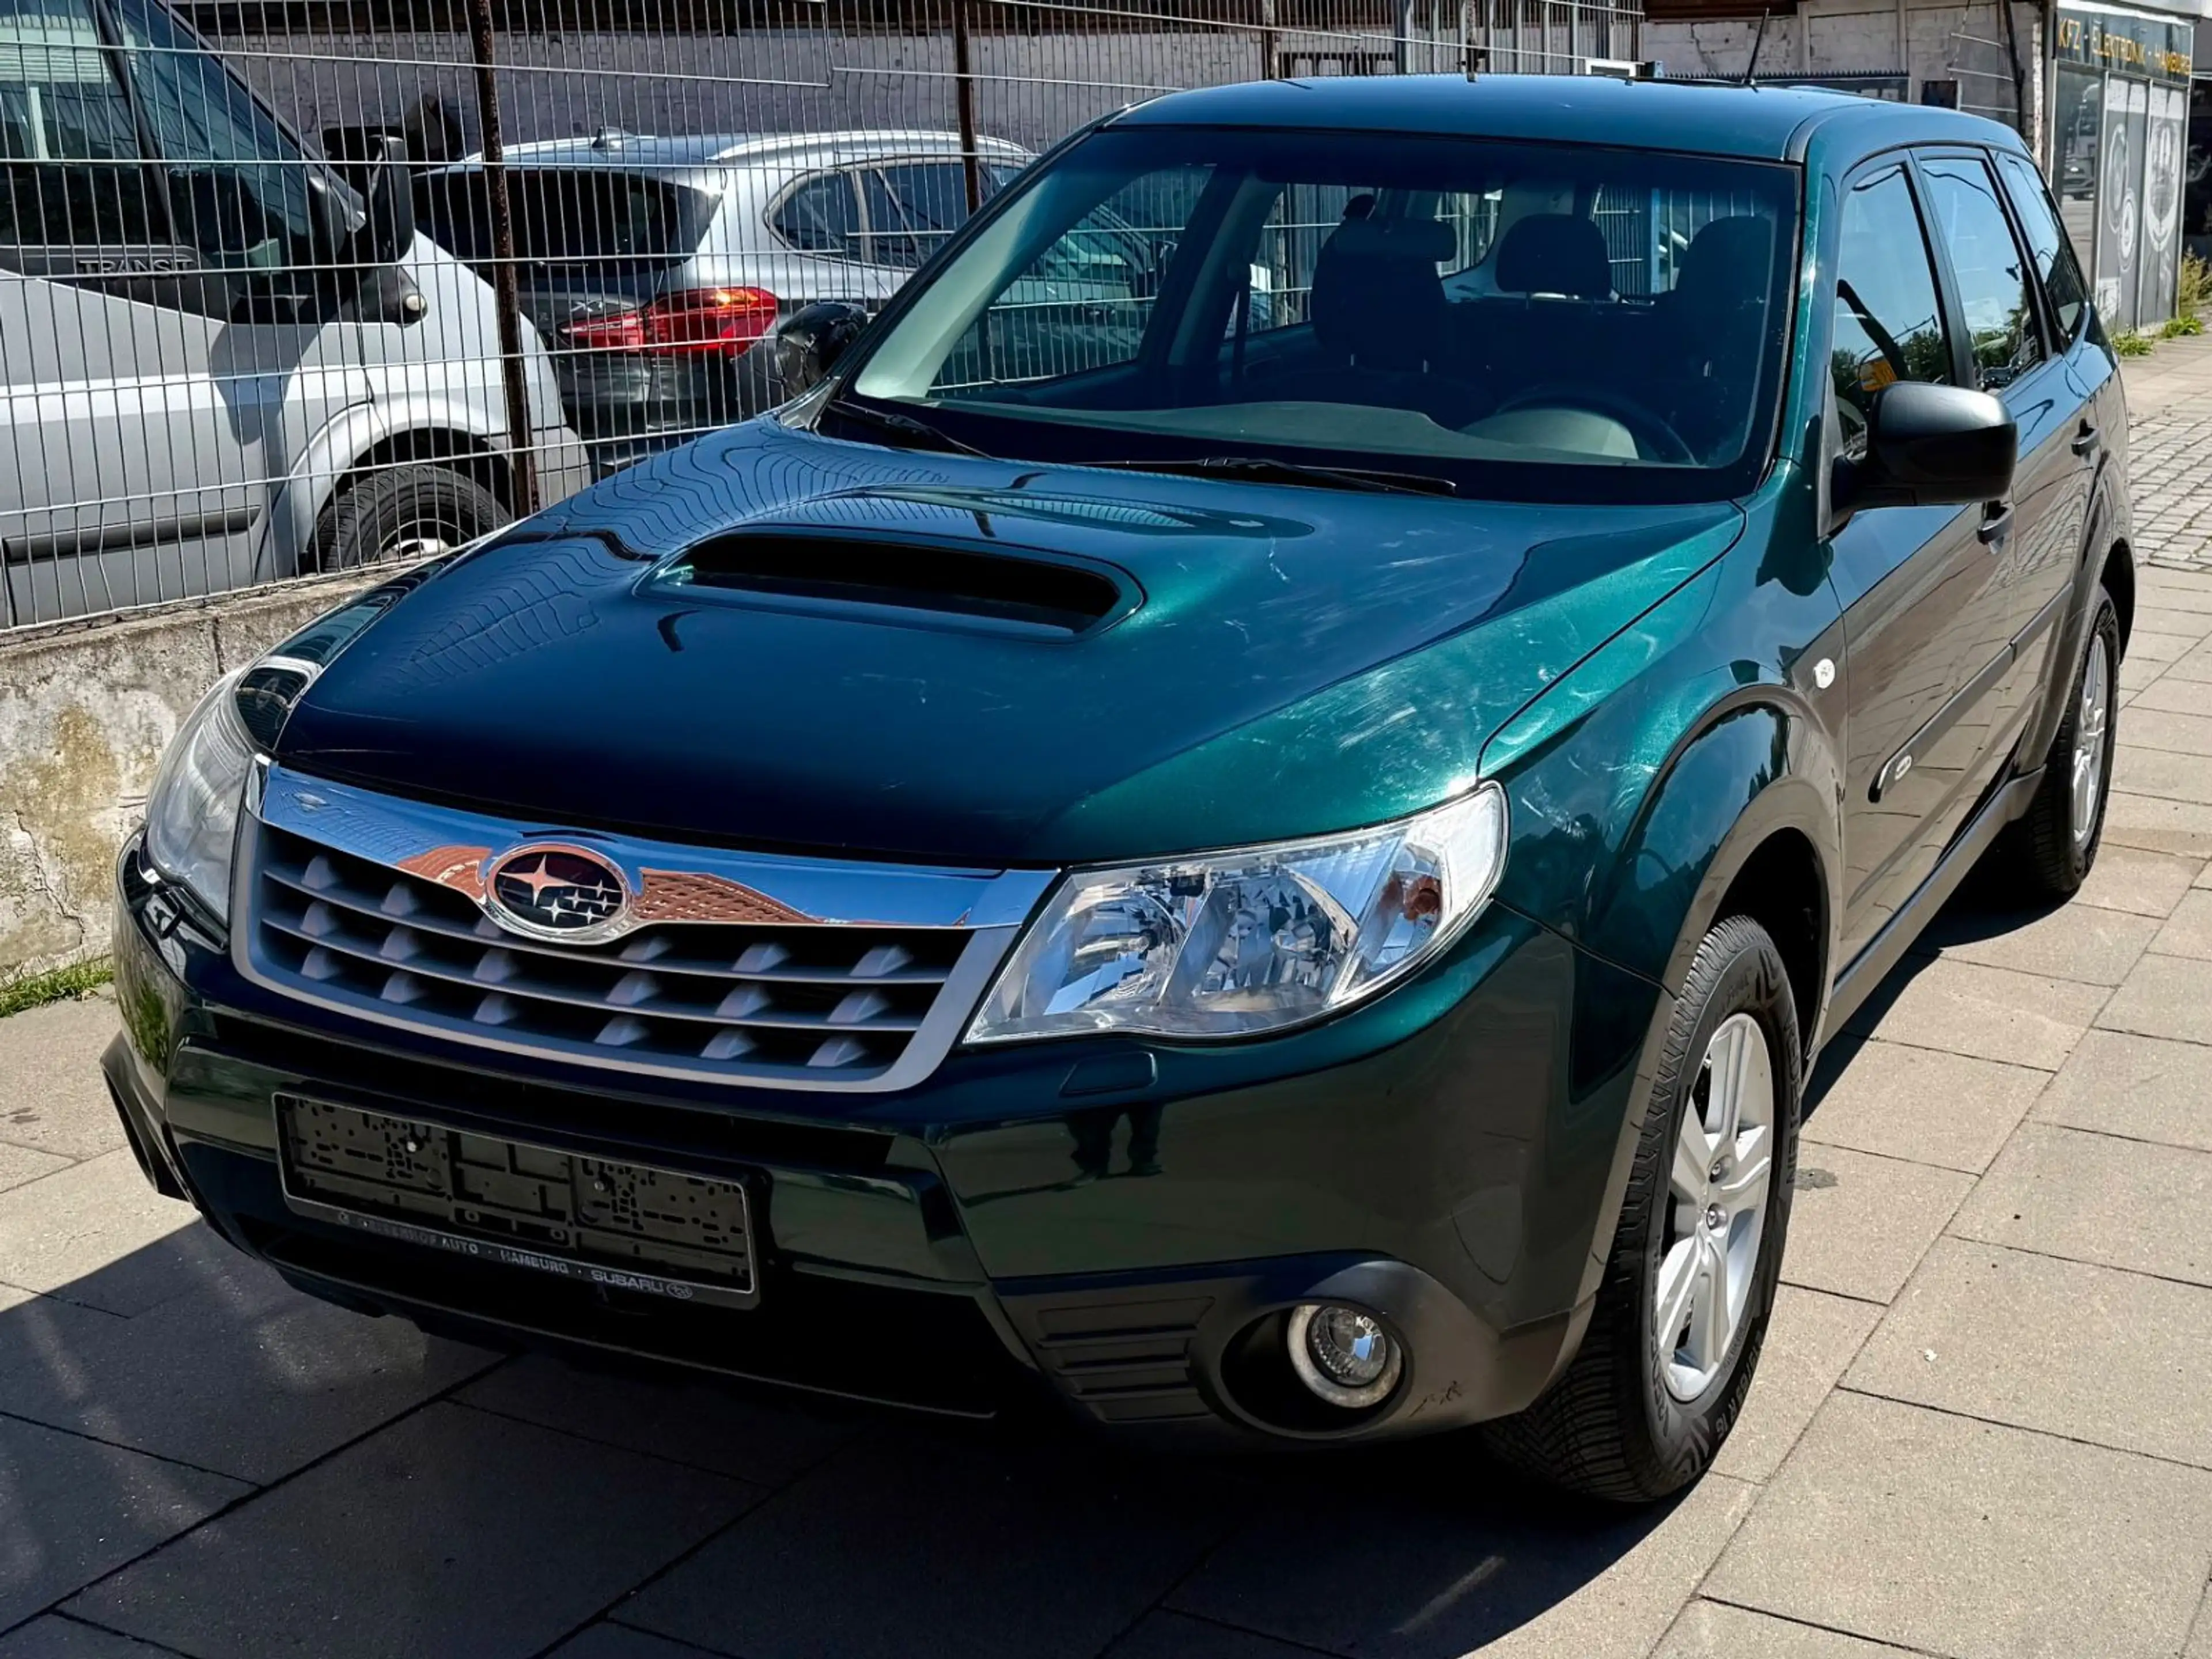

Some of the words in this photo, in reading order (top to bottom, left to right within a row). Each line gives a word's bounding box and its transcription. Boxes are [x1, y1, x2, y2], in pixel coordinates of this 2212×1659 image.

[2058, 18, 2081, 50] KFZ
[442, 1237, 479, 1254] AUTO
[499, 1249, 570, 1274] HAMBURG
[590, 1270, 665, 1293] SUBARU
